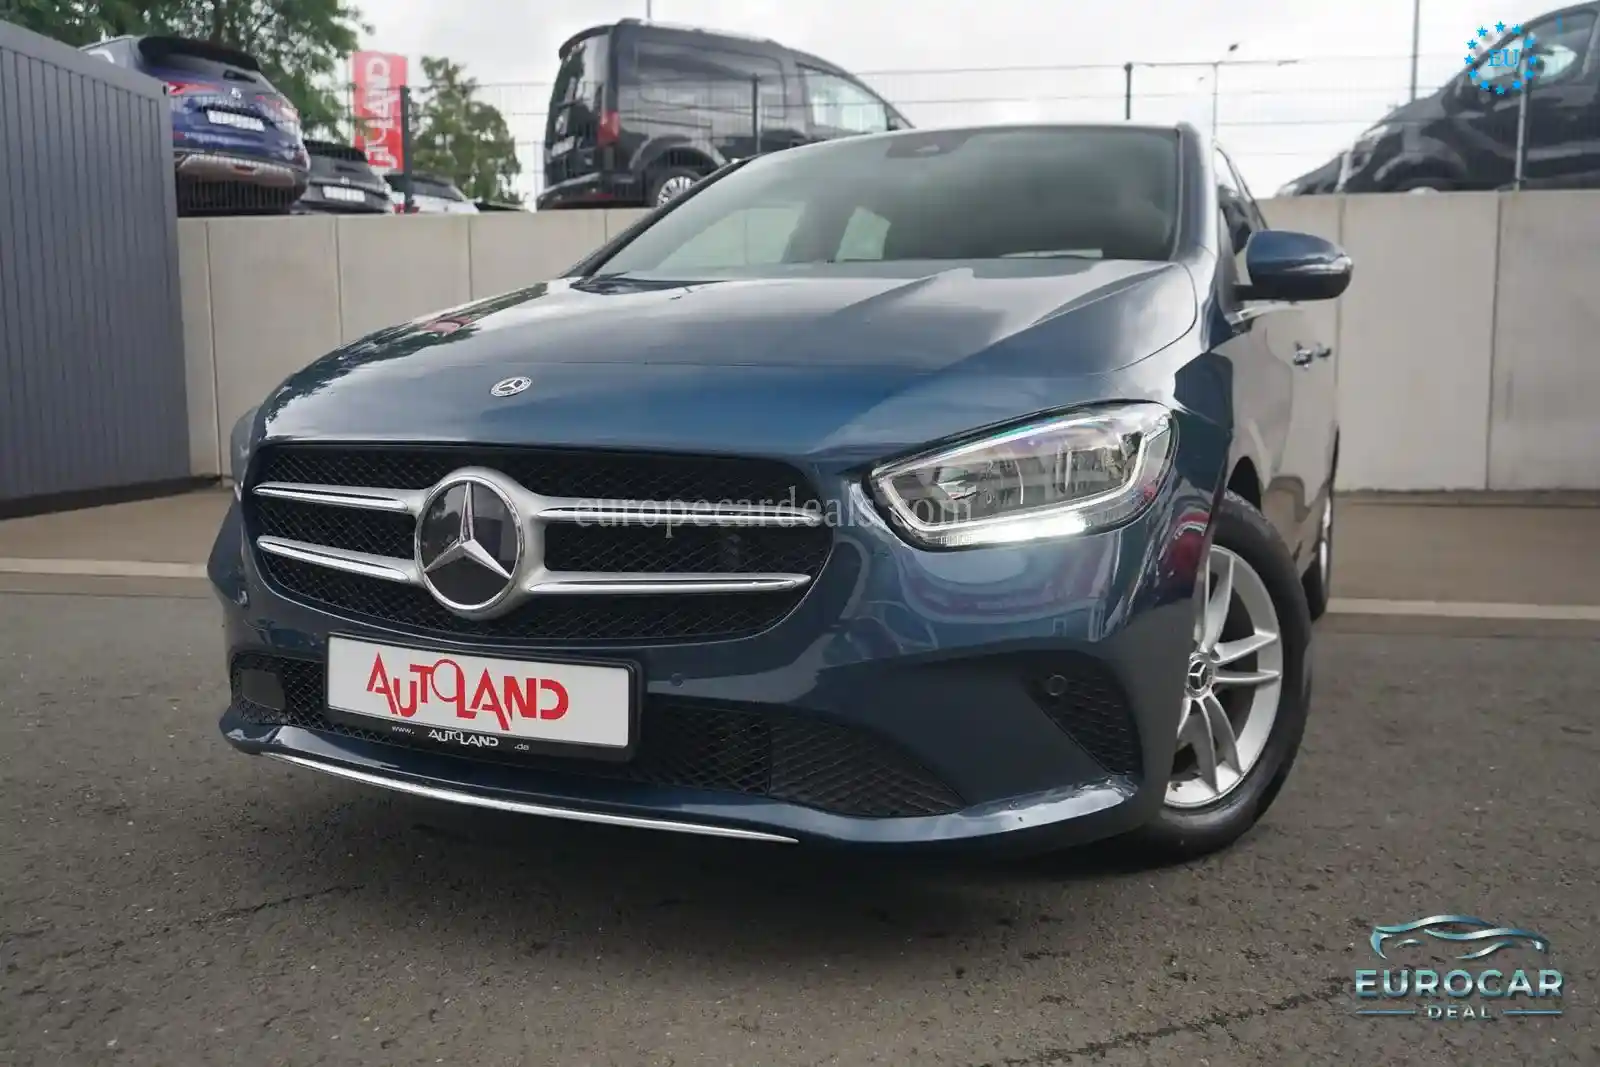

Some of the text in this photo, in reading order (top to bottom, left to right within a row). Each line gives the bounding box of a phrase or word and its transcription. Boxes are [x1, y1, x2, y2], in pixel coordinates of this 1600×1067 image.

[366, 651, 569, 731] AUTOLAND
[391, 725, 415, 735] www.
[428, 729, 499, 747] AUTOLAND
